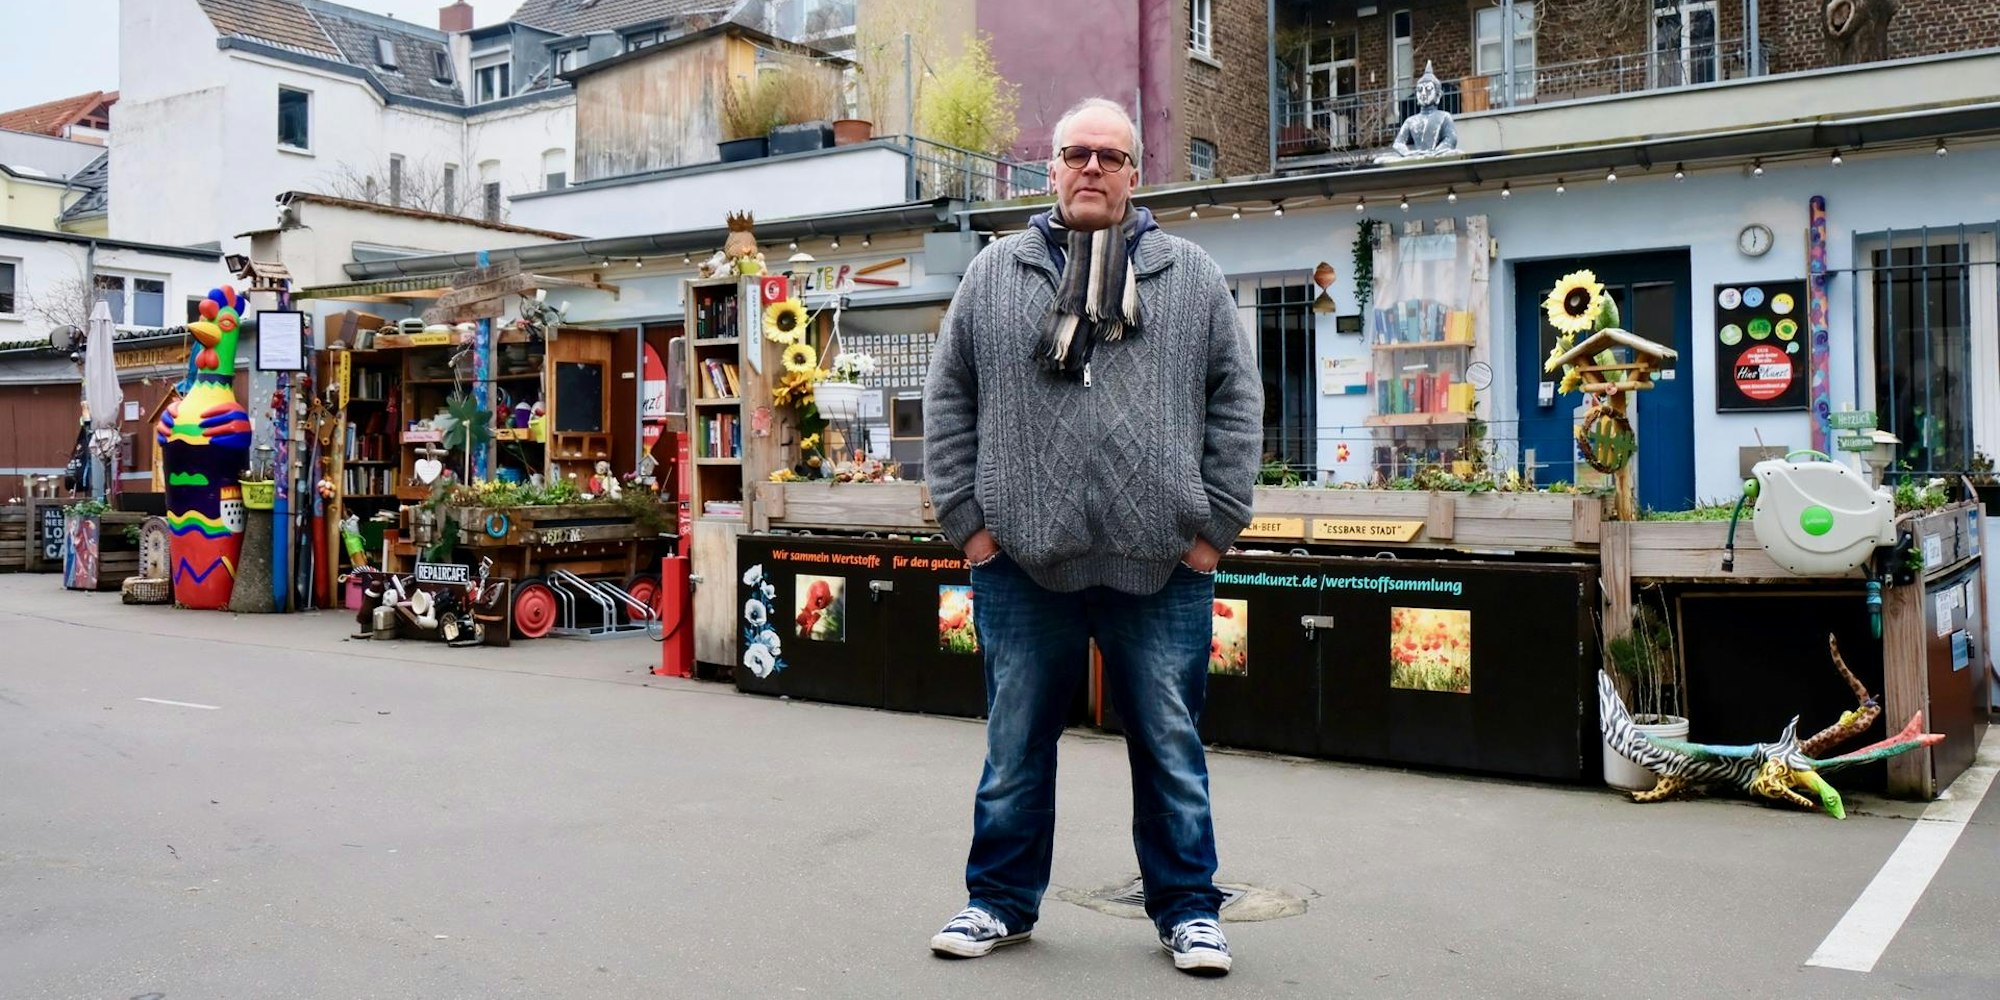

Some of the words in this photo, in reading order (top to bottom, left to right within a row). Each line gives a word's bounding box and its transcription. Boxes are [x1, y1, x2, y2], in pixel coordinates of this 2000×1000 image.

[45, 510, 61, 518] ALL
[772, 550, 788, 560] Wir
[790, 552, 829, 562] sammeln
[831, 554, 880, 568] Wertstoffe
[893, 556, 909, 570] für
[910, 557, 929, 568] den
[931, 559, 961, 571] guten
[418, 565, 467, 582] REPAIRCAFE
